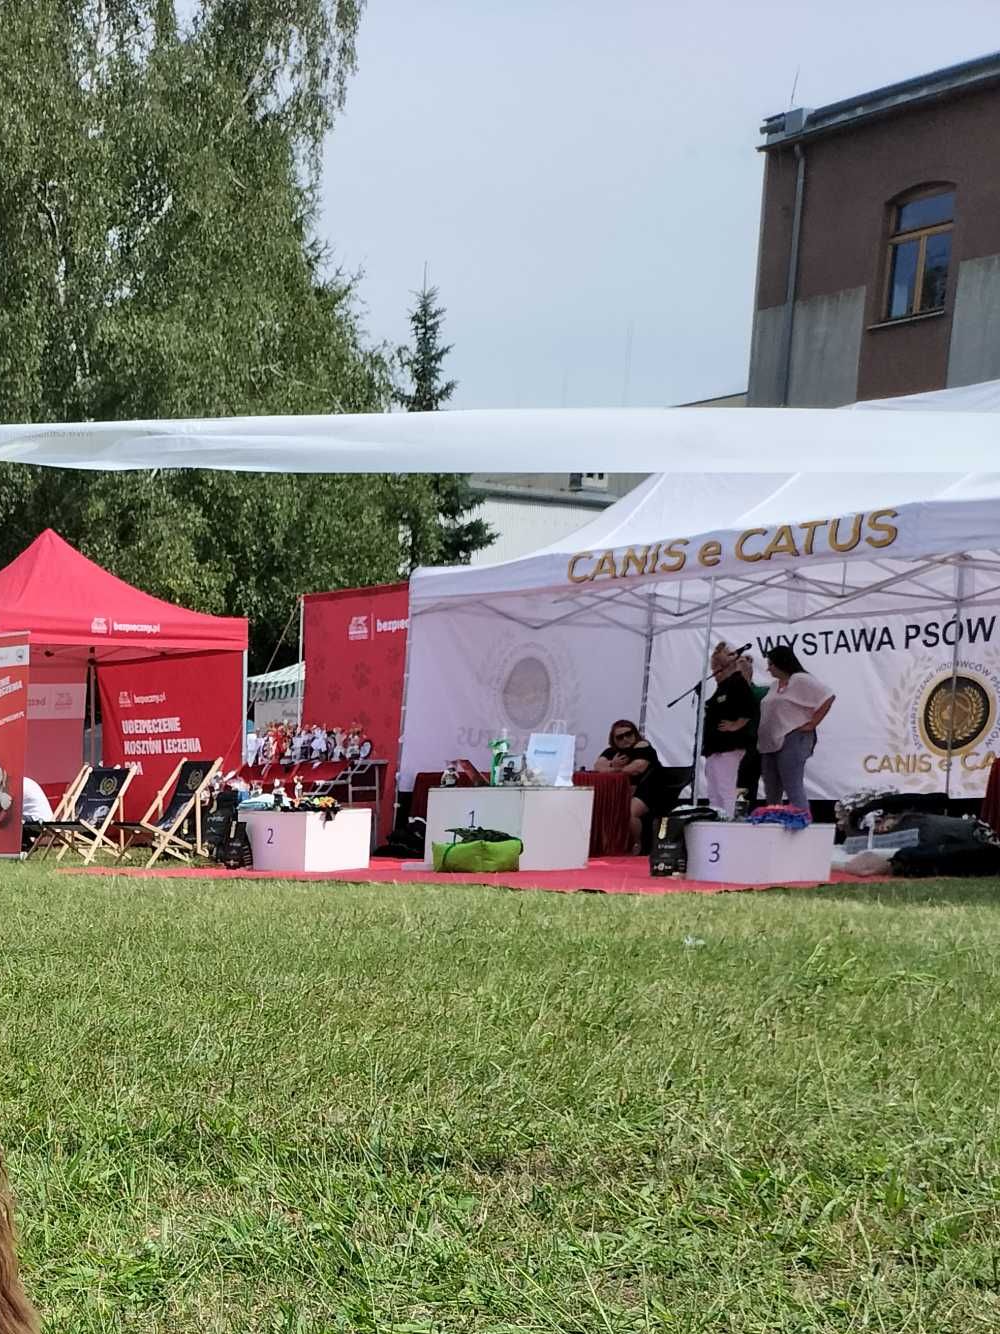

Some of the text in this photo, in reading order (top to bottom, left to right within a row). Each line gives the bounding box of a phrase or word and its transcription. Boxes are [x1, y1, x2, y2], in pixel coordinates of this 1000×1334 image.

[567, 508, 898, 583] CANIS e CATUS
[756, 613, 996, 659] WYSTAWA PSÓW
[121, 716, 182, 734] UBEZPIECZENIE
[124, 736, 202, 755] KOSZTÓW LECZENIA
[863, 753, 932, 773] CANIS
[468, 810, 476, 828] 1
[266, 828, 275, 844] 2
[708, 842, 721, 863] 3
